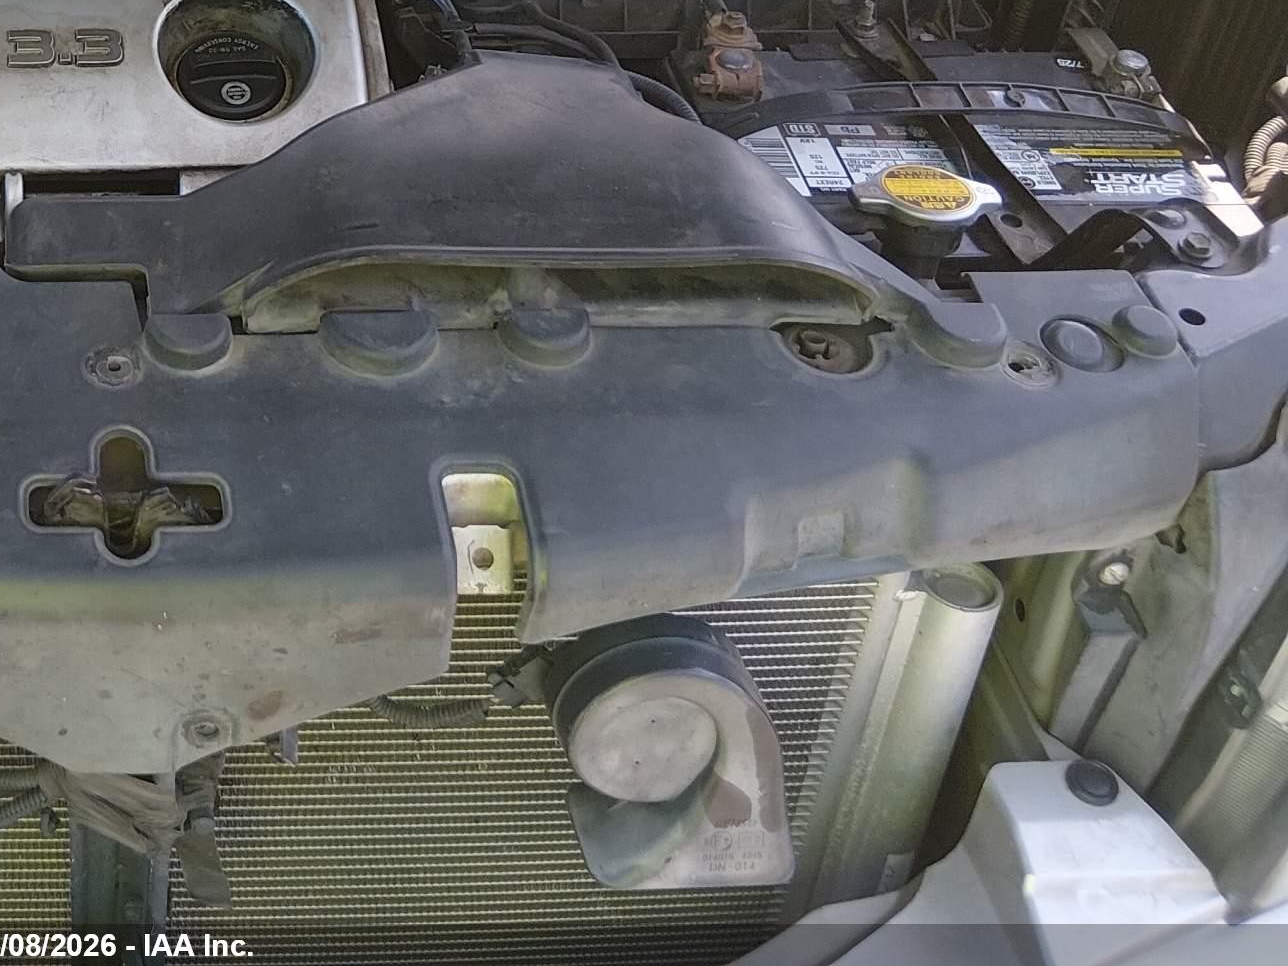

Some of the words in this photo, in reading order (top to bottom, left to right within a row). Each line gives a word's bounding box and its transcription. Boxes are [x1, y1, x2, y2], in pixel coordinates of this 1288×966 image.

[5, 28, 126, 70] 3.3
[840, 126, 861, 134] Pb
[1090, 172, 1186, 185] START
[1094, 183, 1183, 196] SUPER
[903, 194, 965, 204] CAUTION
